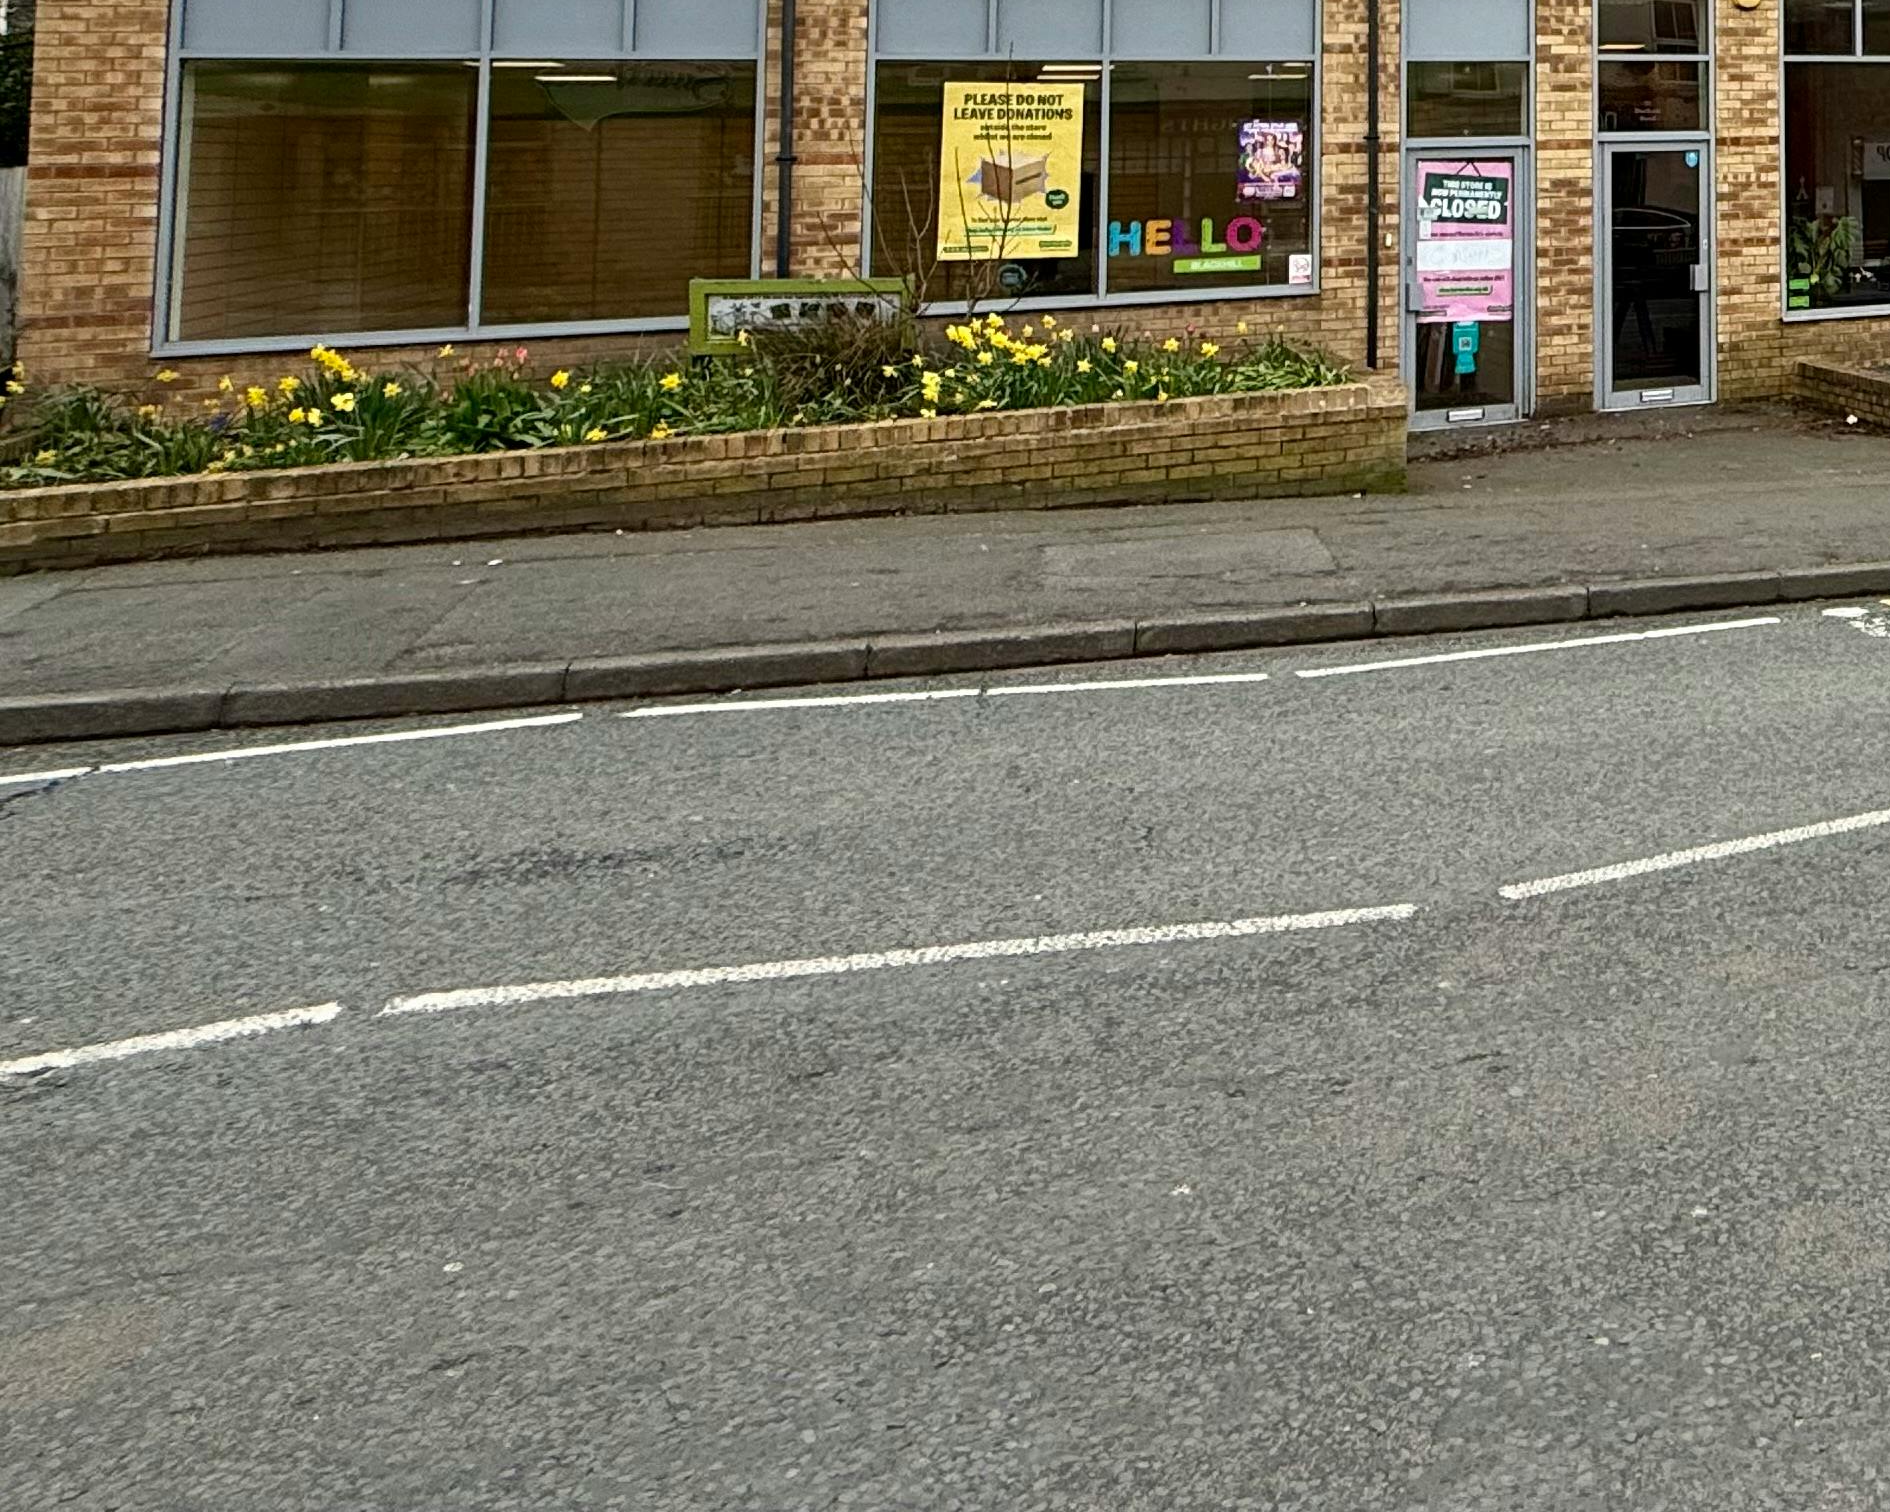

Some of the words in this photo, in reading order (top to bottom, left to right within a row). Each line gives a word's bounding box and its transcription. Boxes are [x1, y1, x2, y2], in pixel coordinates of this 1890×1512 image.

[964, 94, 1013, 106] PLEASE
[1016, 94, 1034, 105] DO
[1037, 94, 1064, 105] NOT
[954, 108, 996, 120] LEAVE
[997, 108, 1073, 120] DONATIONS
[1430, 198, 1501, 219] CLOSED
[1108, 217, 1264, 257] HELLO
